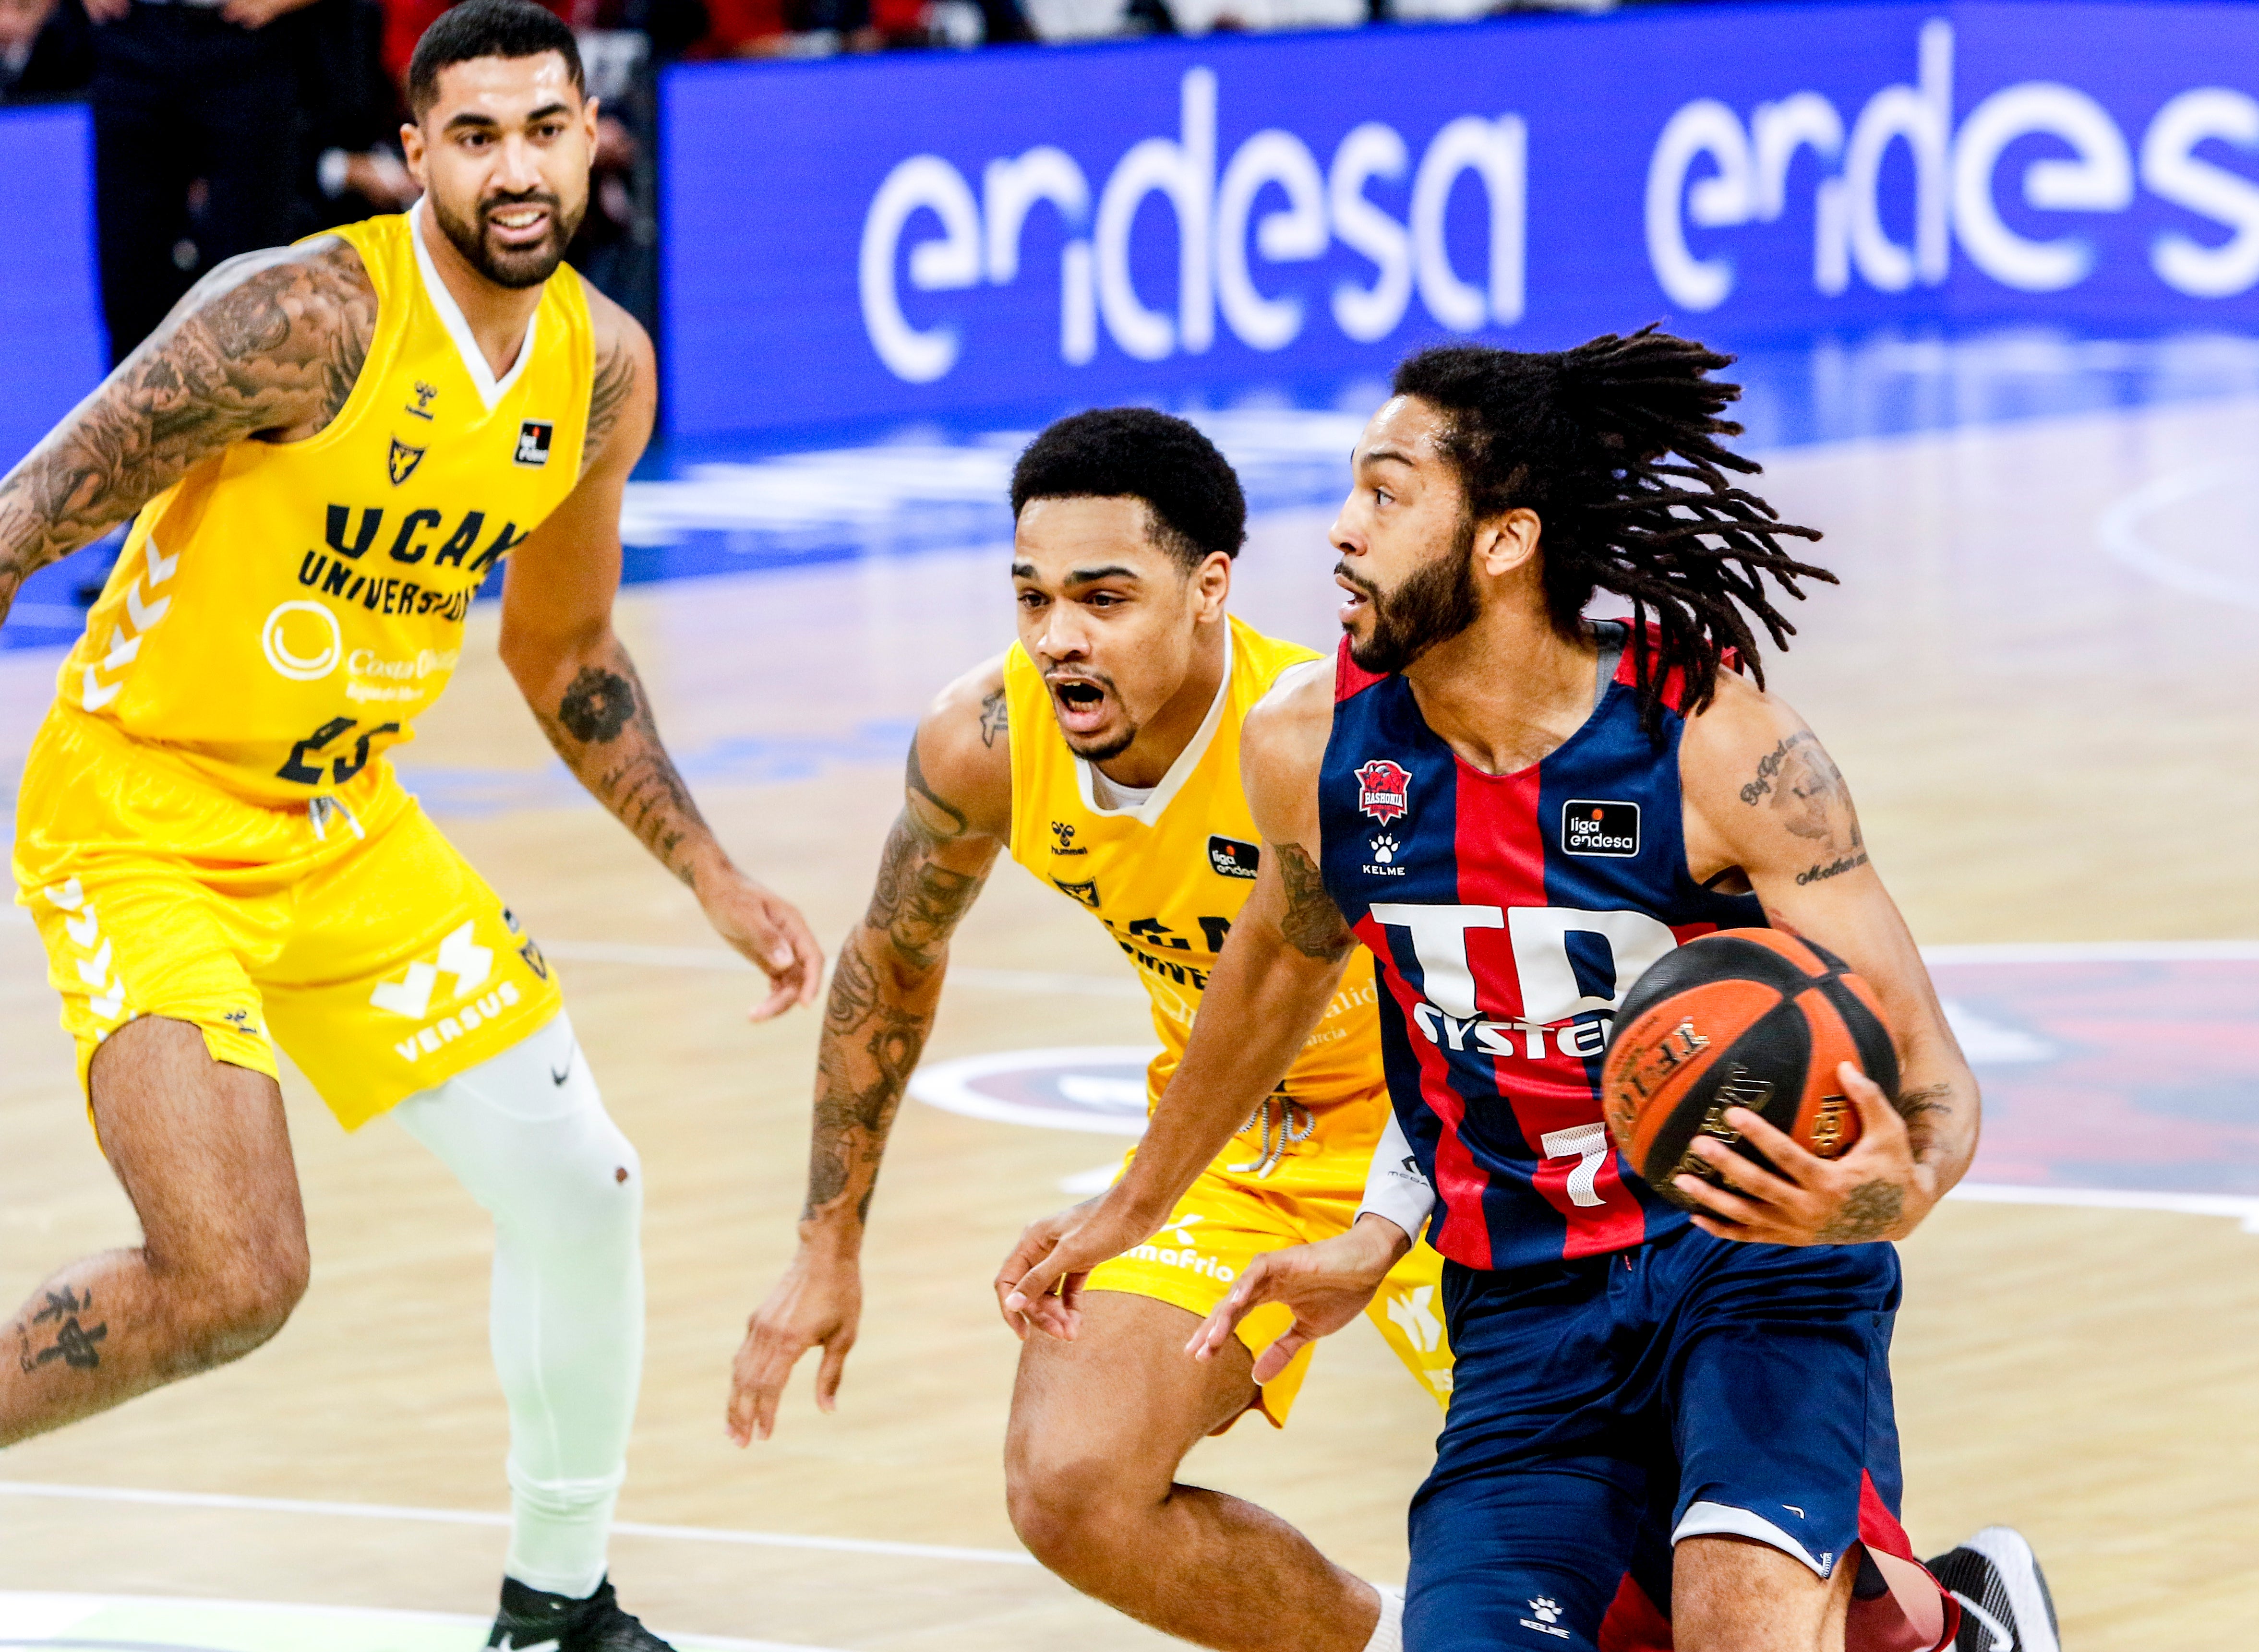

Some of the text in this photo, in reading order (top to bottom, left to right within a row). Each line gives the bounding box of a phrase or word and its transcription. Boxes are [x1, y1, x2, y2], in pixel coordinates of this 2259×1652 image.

[859, 63, 1527, 384] endesa
[1570, 833, 1633, 849] endesa
[1571, 817, 1600, 834] liga
[1212, 850, 1237, 865] liga
[1363, 864, 1406, 876] KELME
[1369, 903, 1679, 1024] TD
[394, 980, 520, 1063] VERSUS
[1413, 1002, 1614, 1060] SYSTE
[1540, 1121, 1608, 1207] 7
